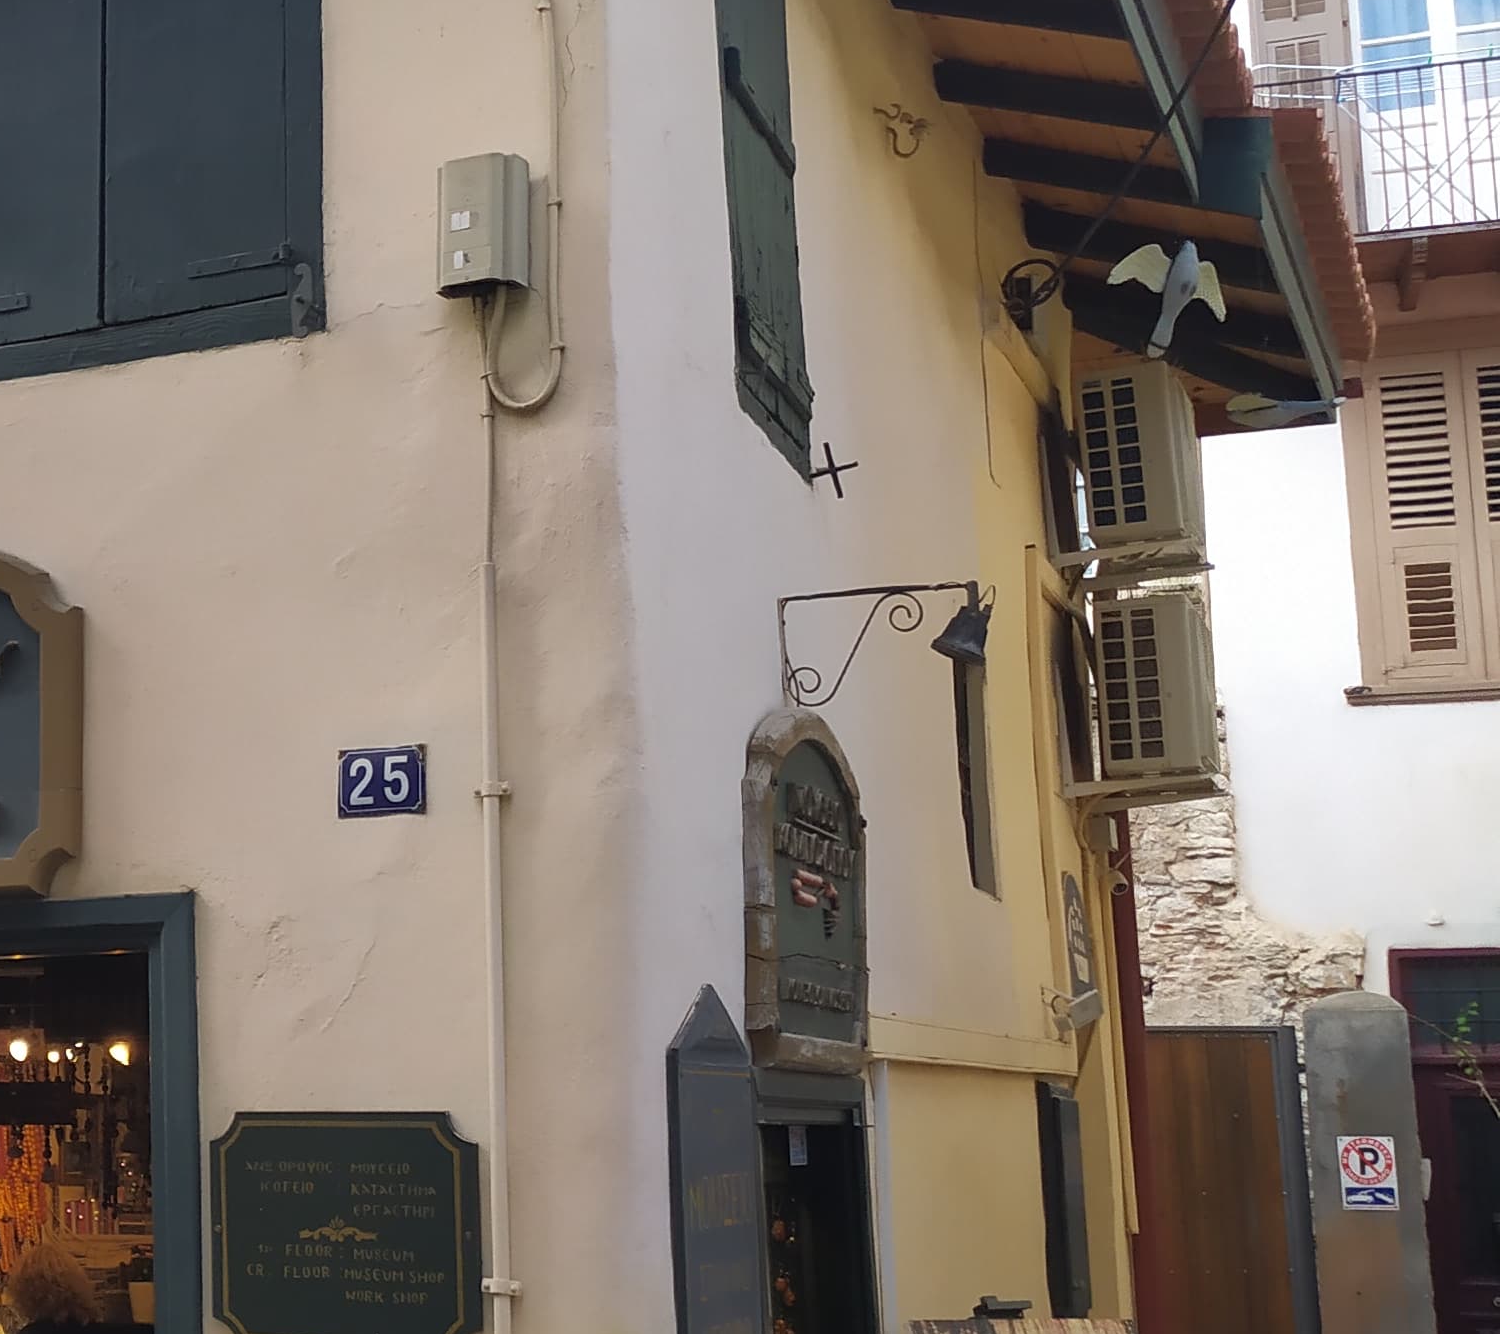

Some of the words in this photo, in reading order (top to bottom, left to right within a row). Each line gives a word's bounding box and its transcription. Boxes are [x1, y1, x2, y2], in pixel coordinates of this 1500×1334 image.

[349, 755, 409, 805] 25
[285, 1244, 332, 1258] FLOOR
[353, 1248, 415, 1262] MUSEUM
[283, 1266, 330, 1279] FLOOR
[409, 1270, 445, 1284] SHOP
[392, 1291, 429, 1305] SHOP
